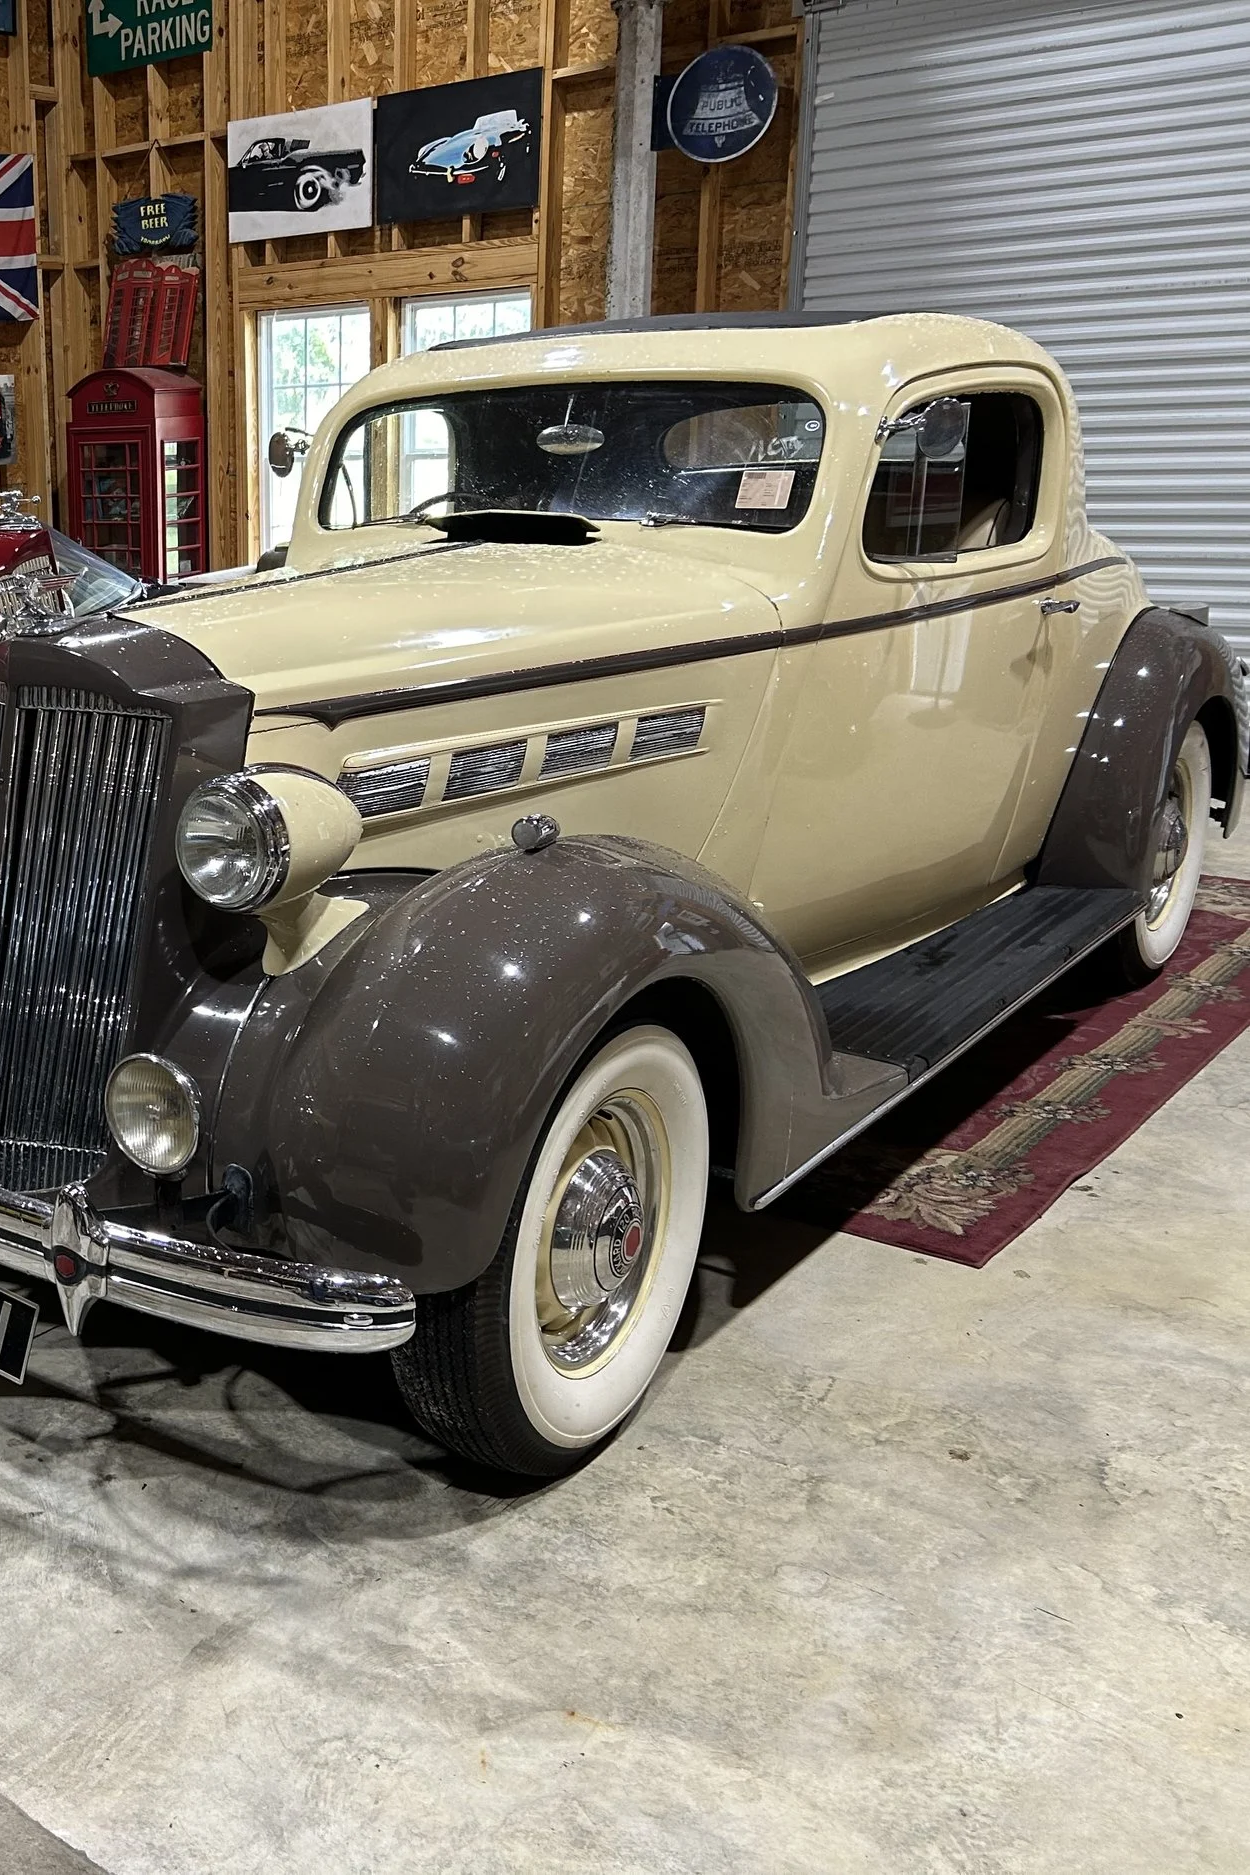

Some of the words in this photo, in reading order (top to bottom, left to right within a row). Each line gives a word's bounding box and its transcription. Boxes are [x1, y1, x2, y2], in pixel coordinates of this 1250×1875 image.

[121, 9, 210, 61] PARKING
[701, 96, 743, 111] PUBLIC
[140, 203, 167, 217] FREE
[141, 216, 169, 230] BEER
